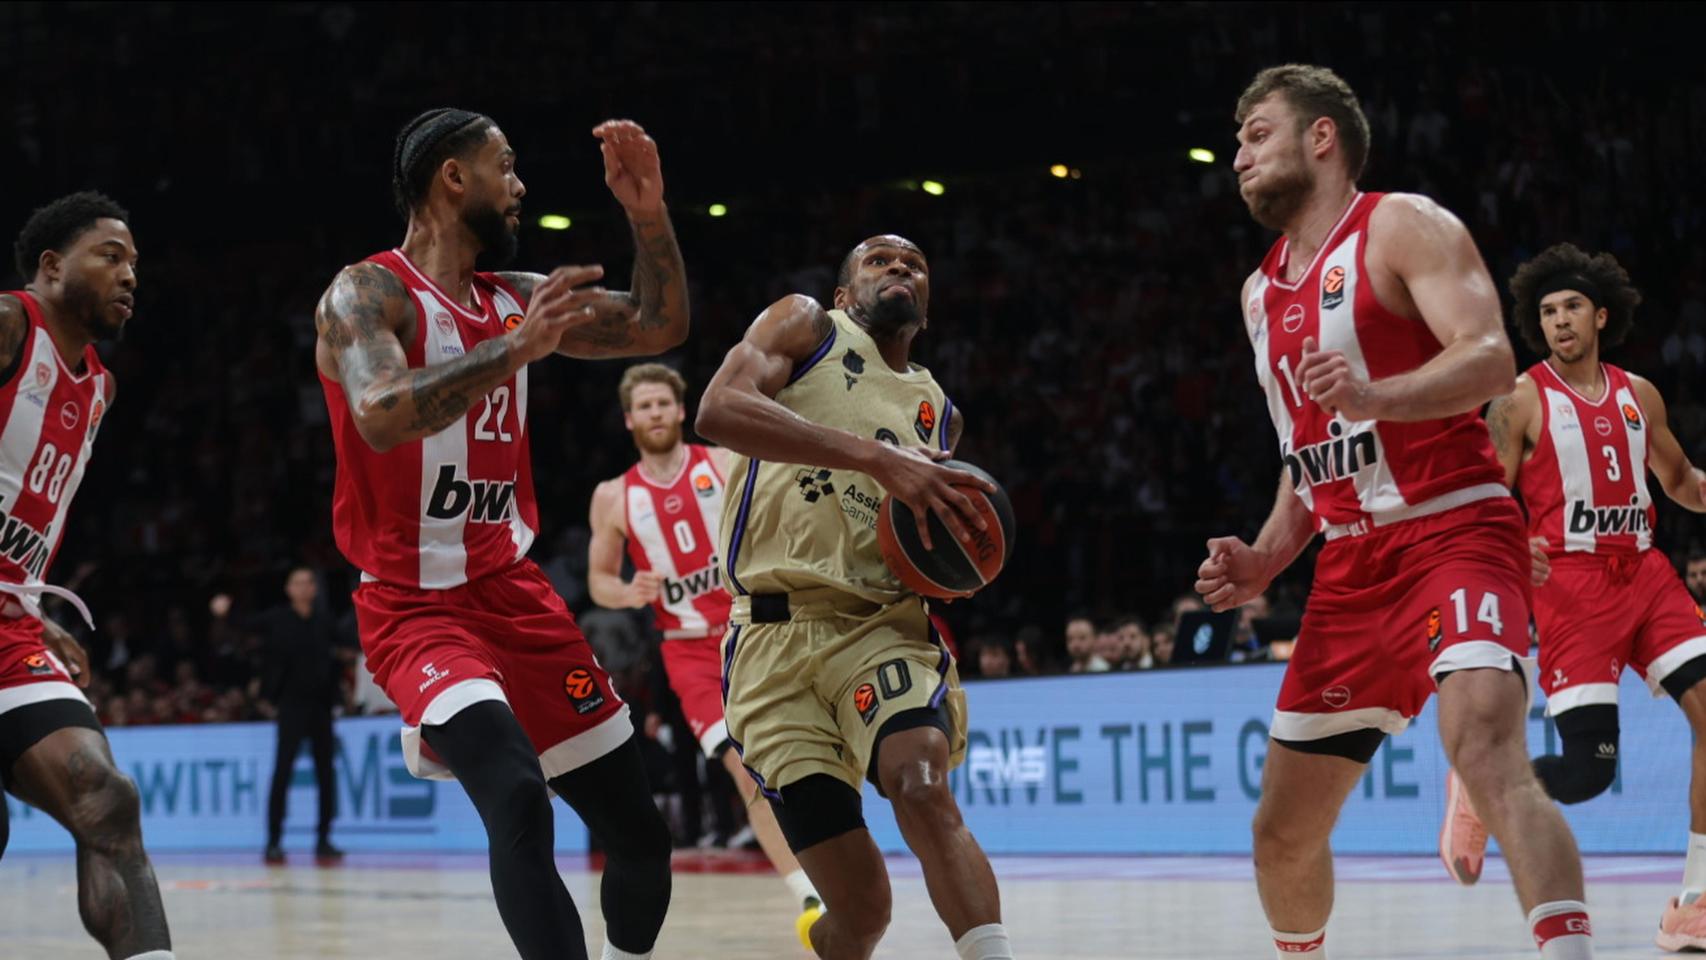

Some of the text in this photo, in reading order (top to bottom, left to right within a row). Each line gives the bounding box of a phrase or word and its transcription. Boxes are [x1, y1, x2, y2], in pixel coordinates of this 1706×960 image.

[1278, 355, 1303, 407] 1
[474, 386, 513, 442] 22
[29, 443, 72, 503] 88
[1603, 445, 1621, 482] 3
[673, 520, 696, 553] 0
[1450, 588, 1503, 636] 14
[877, 658, 912, 699] 0
[1101, 720, 1216, 804] THE
